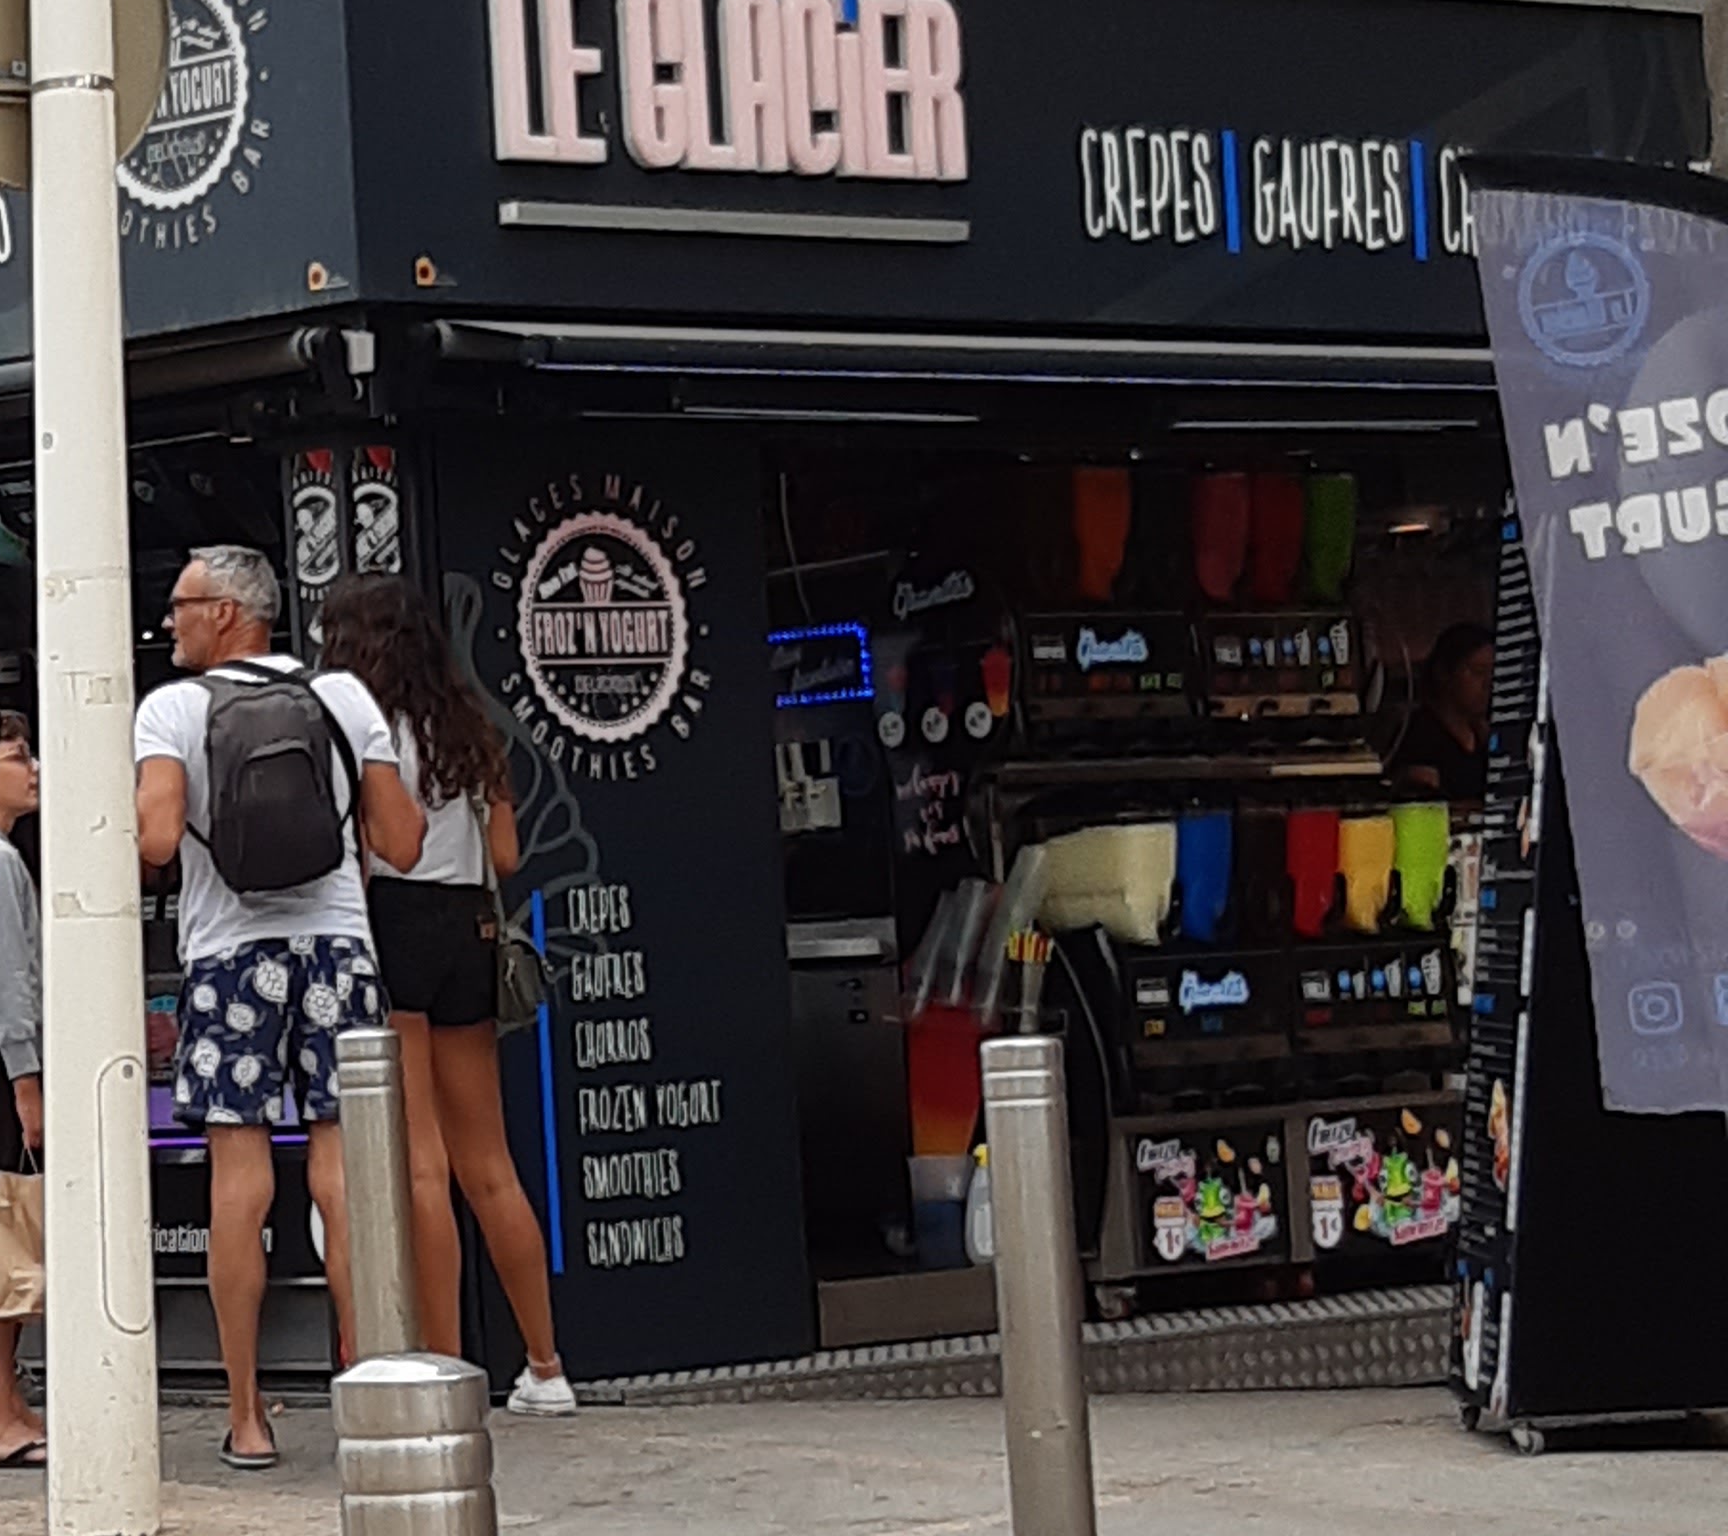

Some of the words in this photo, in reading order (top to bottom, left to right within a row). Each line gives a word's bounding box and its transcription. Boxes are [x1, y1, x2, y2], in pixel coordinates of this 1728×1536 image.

[170, 61, 232, 115] YOGURT
[231, 118, 271, 195] BAR
[1080, 127, 1215, 244] CREPES
[1253, 136, 1404, 251] GAUFRES
[121, 204, 218, 249] OTHIES
[492, 474, 582, 590] GLACES
[604, 474, 707, 590] MAISON
[533, 611, 598, 656] FROZ'N
[598, 610, 669, 655] YOGURT
[501, 671, 657, 781] SMOOTHIES
[671, 669, 711, 739] BAR
[579, 1084, 648, 1137] FROZEN
[655, 1079, 722, 1129] YOGURT
[583, 1148, 682, 1199] SMOOTHIES
